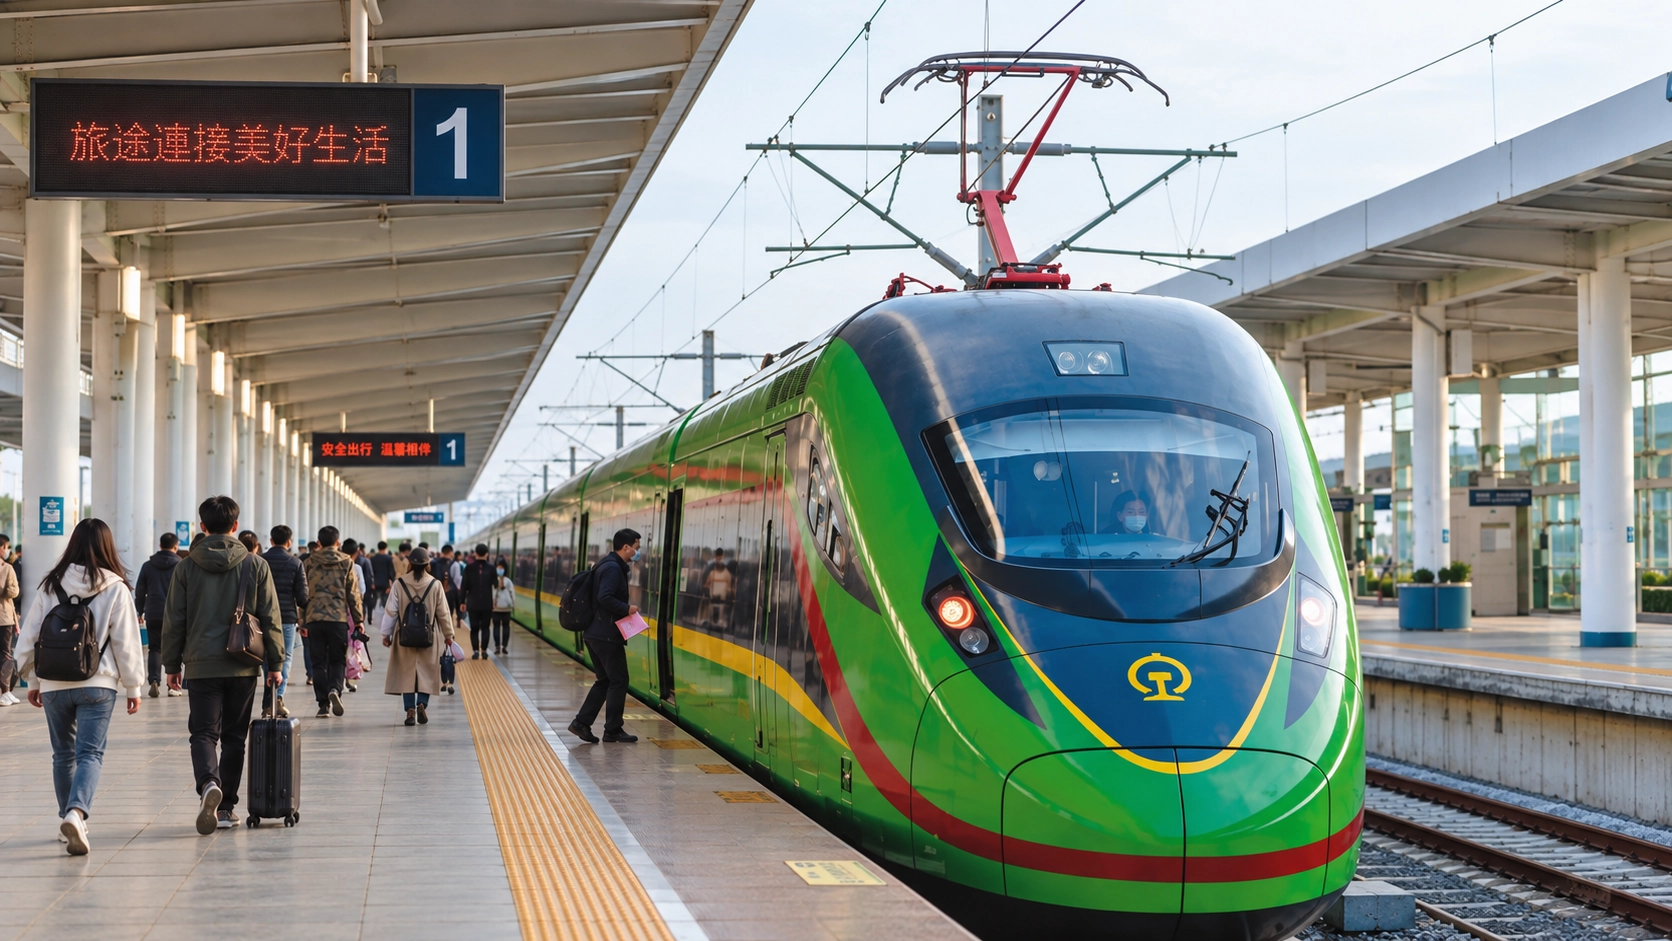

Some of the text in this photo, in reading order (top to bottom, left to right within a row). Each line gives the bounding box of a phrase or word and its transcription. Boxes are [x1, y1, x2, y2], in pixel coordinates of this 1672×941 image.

[70, 121, 389, 165] 旅途連接美好生活
[436, 107, 467, 179] 1
[321, 441, 373, 457] 安全出行
[446, 439, 456, 460] 1
